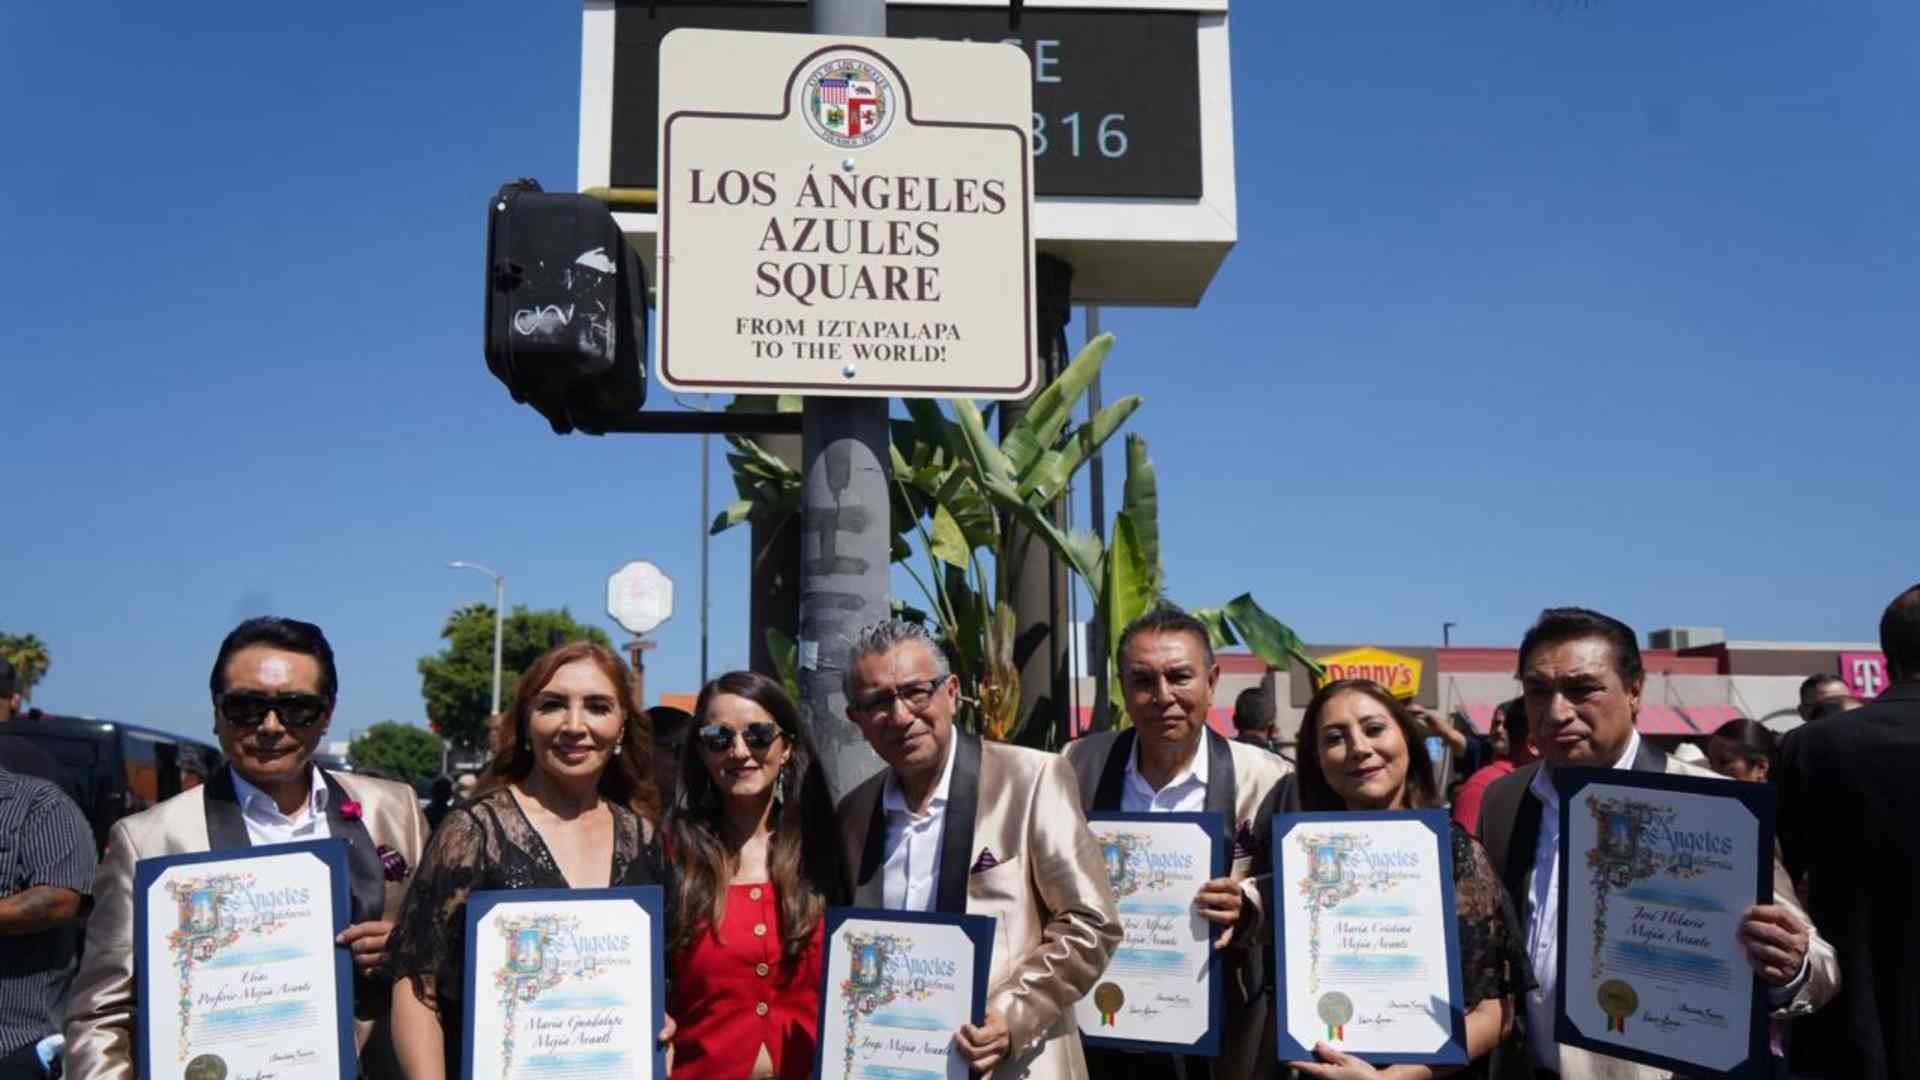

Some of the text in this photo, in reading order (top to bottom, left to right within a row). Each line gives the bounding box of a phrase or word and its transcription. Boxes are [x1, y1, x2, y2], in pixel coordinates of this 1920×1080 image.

[688, 164, 1006, 215] LOS ÁNGELES
[758, 216, 940, 257] AZULES
[755, 261, 941, 306] SQUARE
[736, 317, 961, 341] FROM IZTAPALAPA
[751, 340, 947, 363] TO THE WORLD!
[1328, 663, 1412, 688] Denny's
